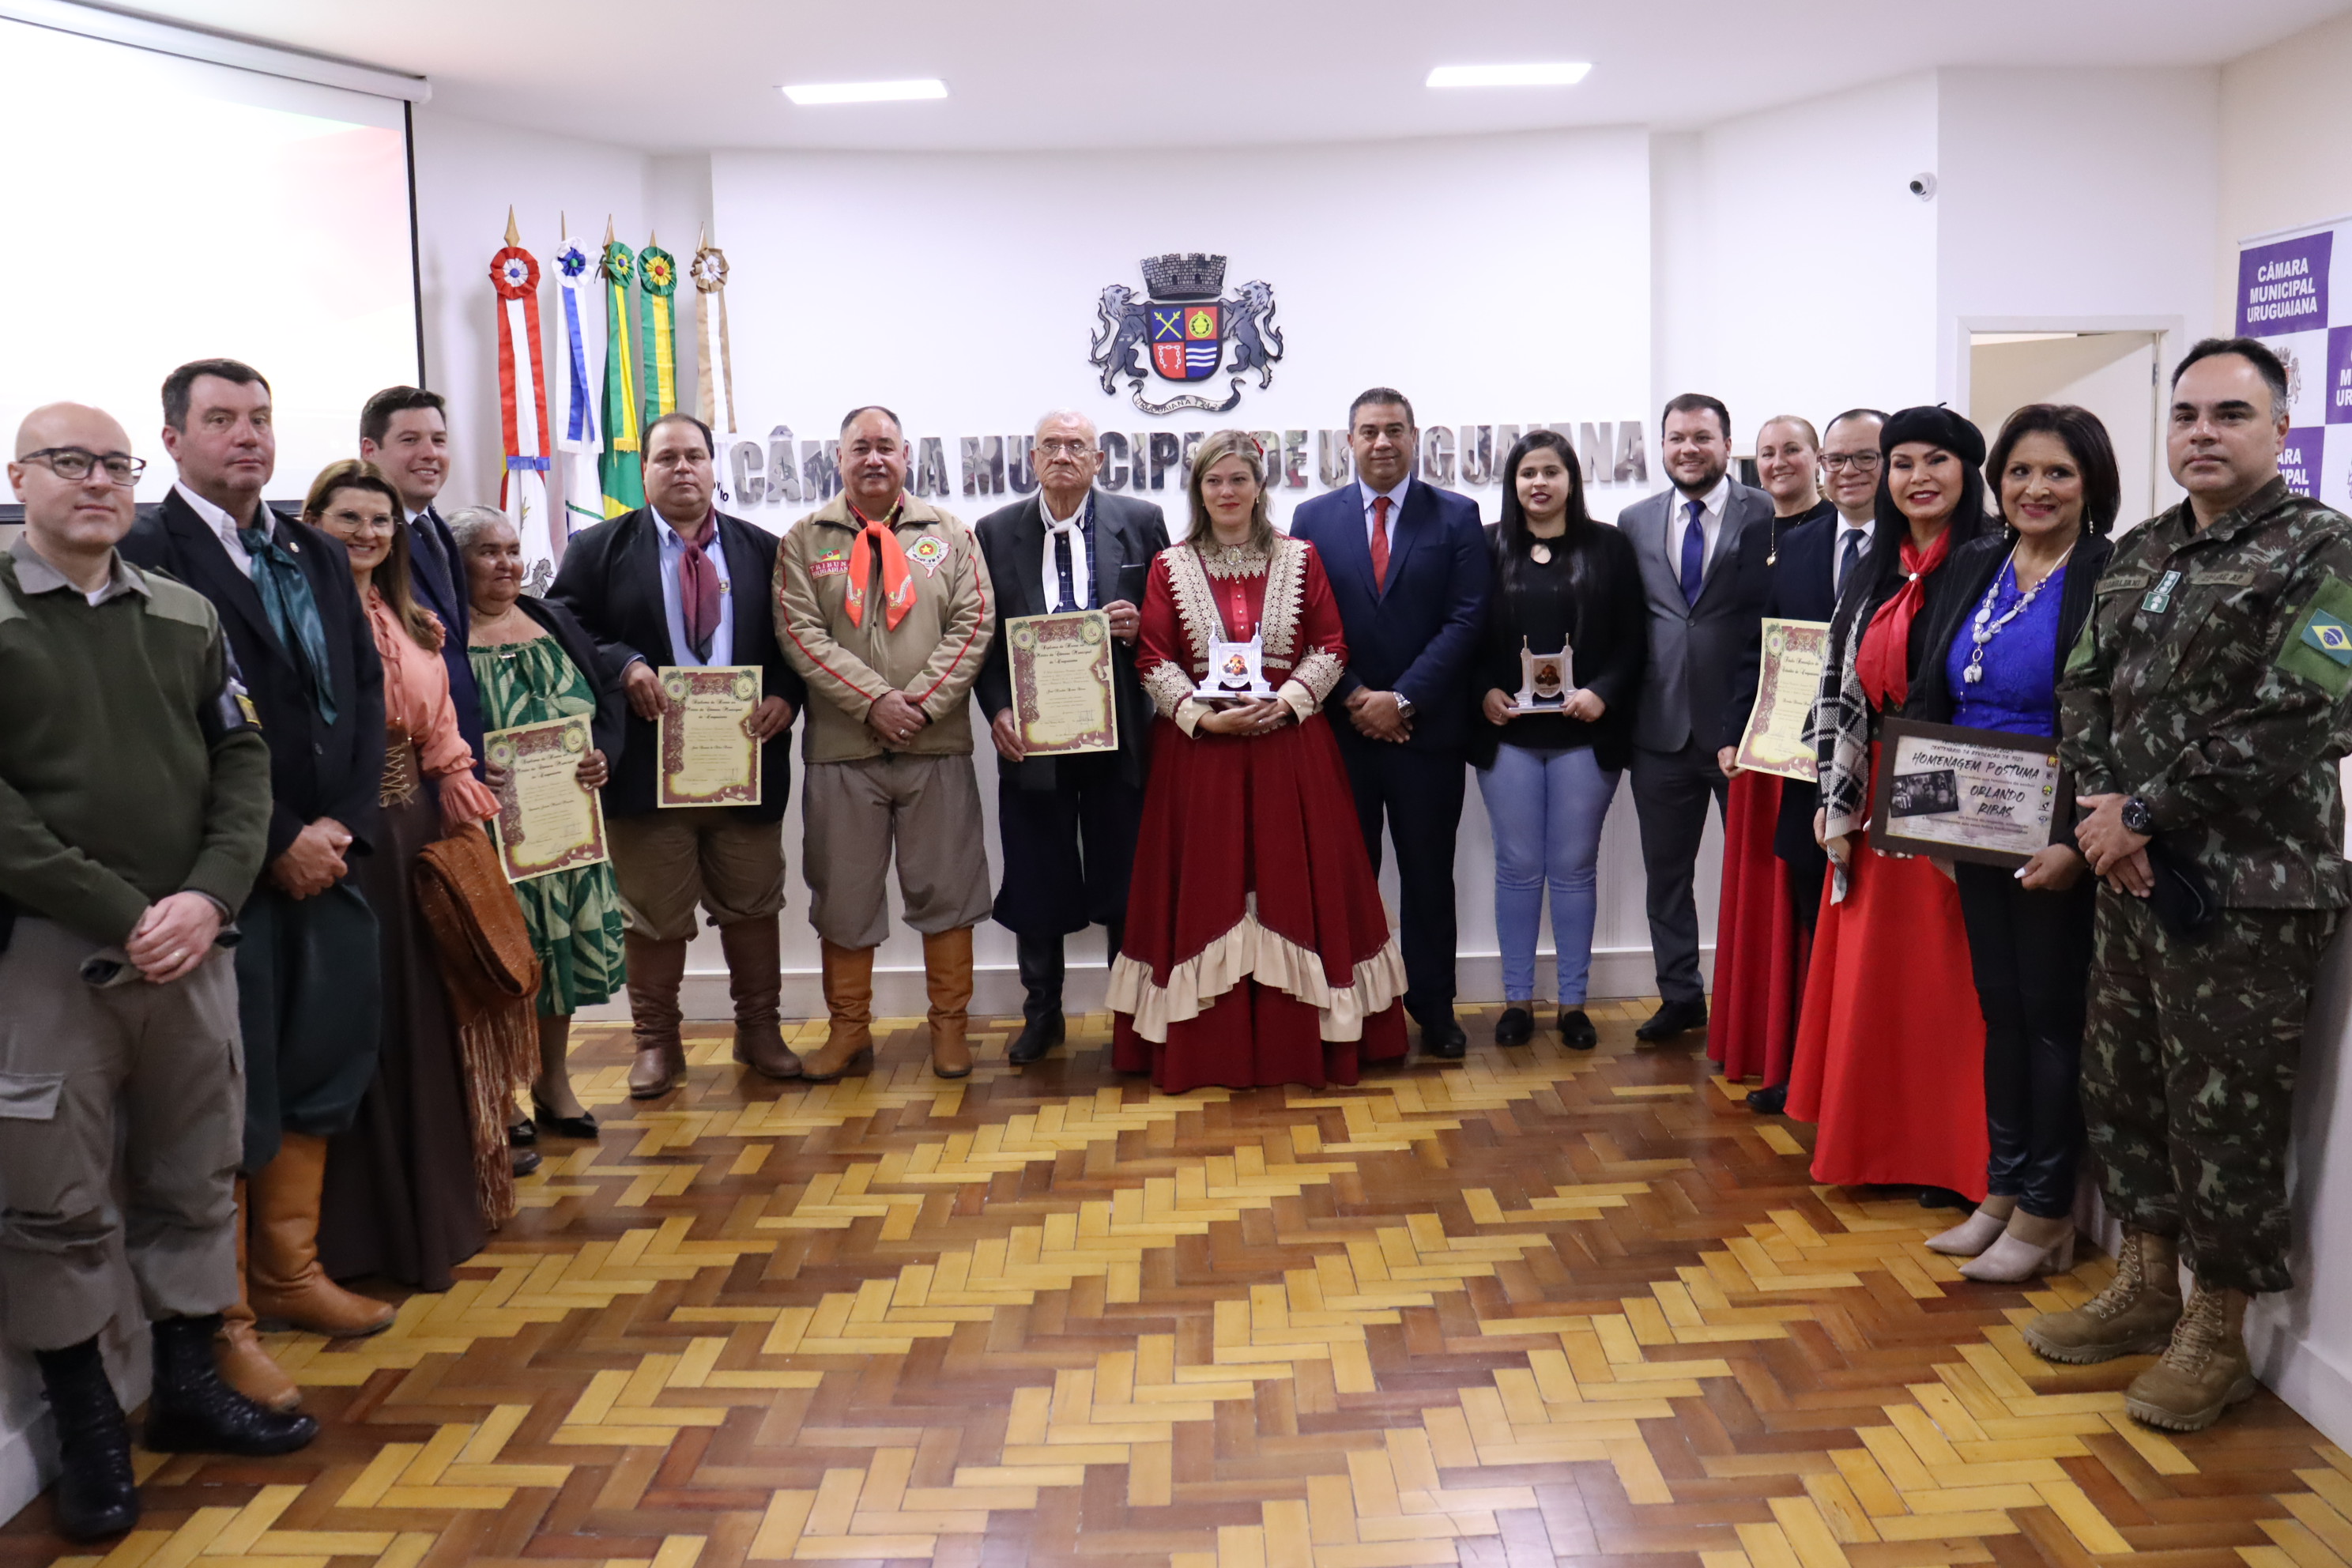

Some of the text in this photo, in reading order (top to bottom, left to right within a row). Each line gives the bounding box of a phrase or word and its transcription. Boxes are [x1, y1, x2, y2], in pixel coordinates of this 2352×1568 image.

[2257, 257, 2309, 283] CÂMARA
[2250, 277, 2316, 304] MUNICIPAL
[2247, 296, 2318, 323] URUGUAIANA
[729, 424, 950, 503] CÂMA
[809, 560, 847, 571] TRIBUN
[812, 566, 849, 577] BRIGADIAN
[1912, 752, 1981, 772] HOMENAGEM
[1969, 784, 2026, 803] ORLANDO
[1977, 801, 2015, 818] RIBAS
